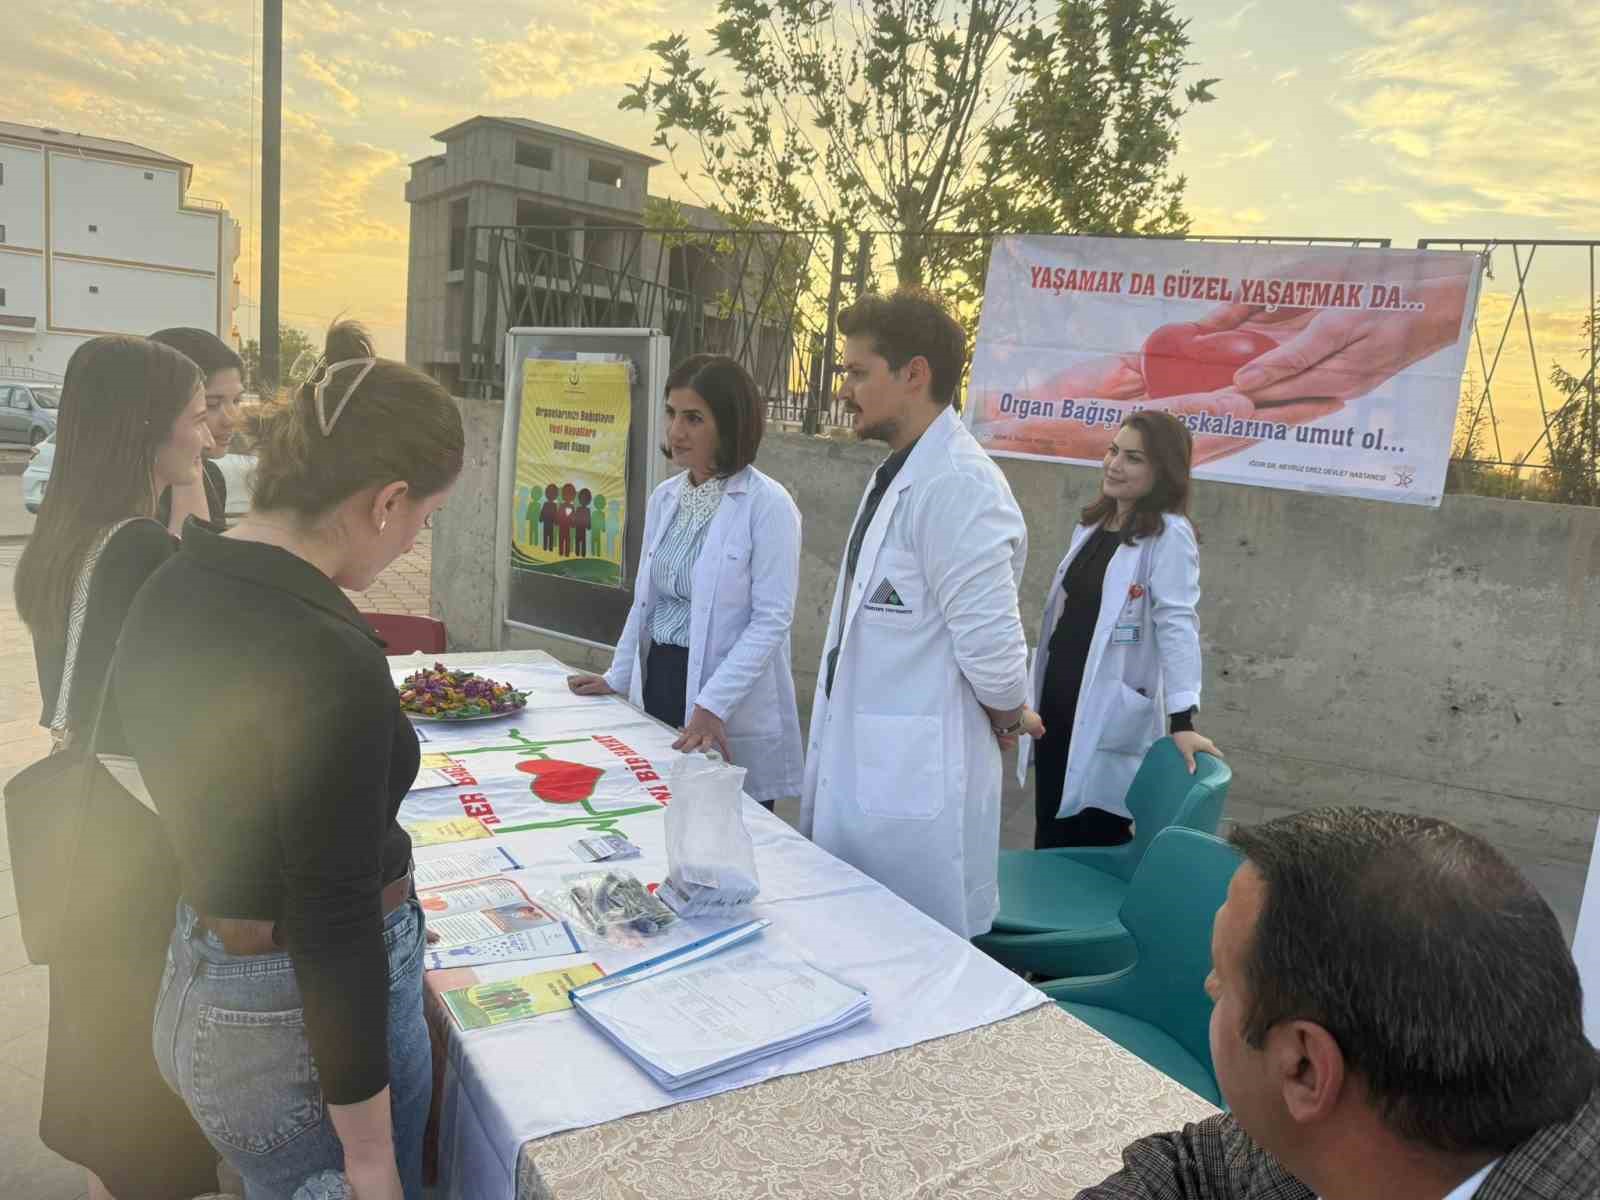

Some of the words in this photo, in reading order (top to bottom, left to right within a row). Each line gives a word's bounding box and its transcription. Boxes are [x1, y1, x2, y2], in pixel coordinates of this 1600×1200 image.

[1030, 265, 1123, 296] YAŞAMAK
[1128, 272, 1155, 296] DA
[1163, 268, 1233, 302] GÜZEL
[1240, 279, 1364, 312] YAŞATMAK
[1368, 283, 1424, 310] DA...
[999, 392, 1054, 420] Organ
[1060, 398, 1123, 429] Bağışı
[1165, 408, 1287, 441] aşkalarına
[1296, 424, 1355, 447] umut
[1361, 427, 1405, 452] ol...
